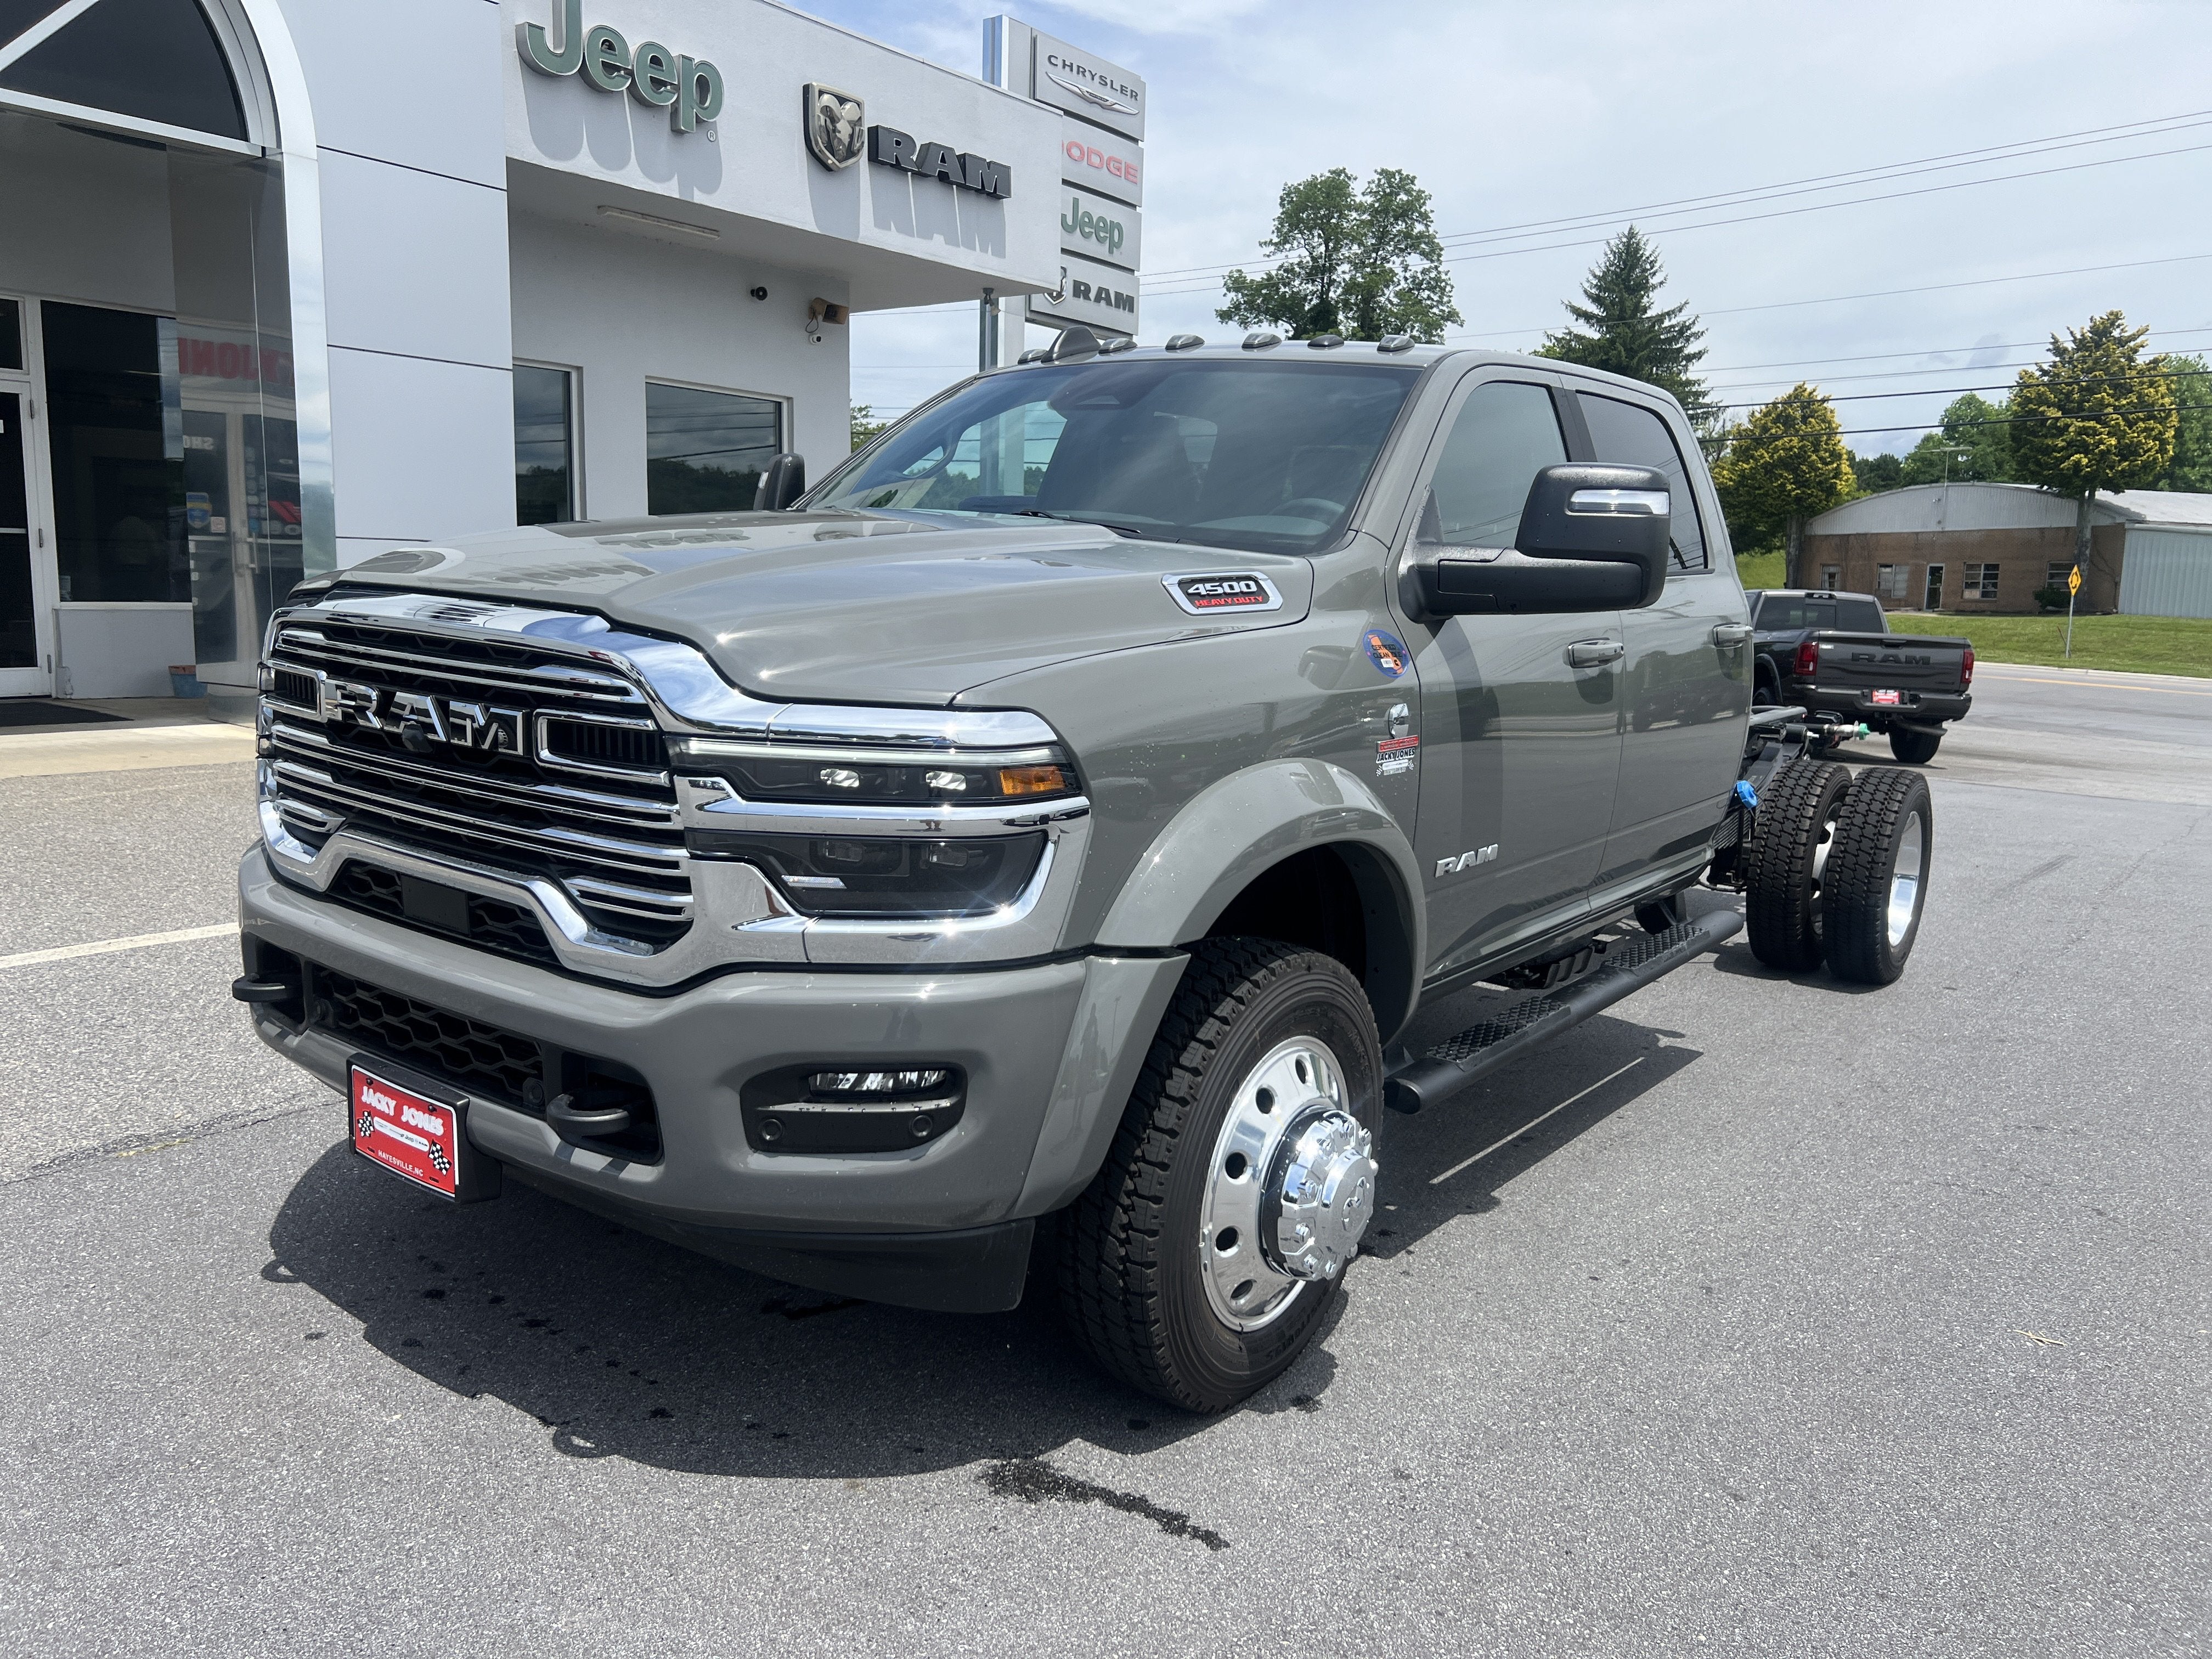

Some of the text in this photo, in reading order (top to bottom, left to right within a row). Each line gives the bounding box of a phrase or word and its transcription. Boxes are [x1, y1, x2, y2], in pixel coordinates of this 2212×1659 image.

[515, 0, 724, 133] Jeep
[1047, 54, 1139, 101] CHRYSLER
[867, 125, 1011, 199] RAM
[1062, 139, 1139, 184] ODGE
[1061, 197, 1124, 254] Jeep
[1073, 279, 1135, 313] RAM
[1187, 581, 1257, 596] 4500
[1195, 596, 1263, 607] HEAVY DUTY
[1852, 652, 1931, 665] RAM
[326, 678, 528, 757] RAM
[1376, 747, 1415, 763] JACKY JONES
[1435, 843, 1498, 878] RAM
[362, 1086, 444, 1136] JACKY JONES
